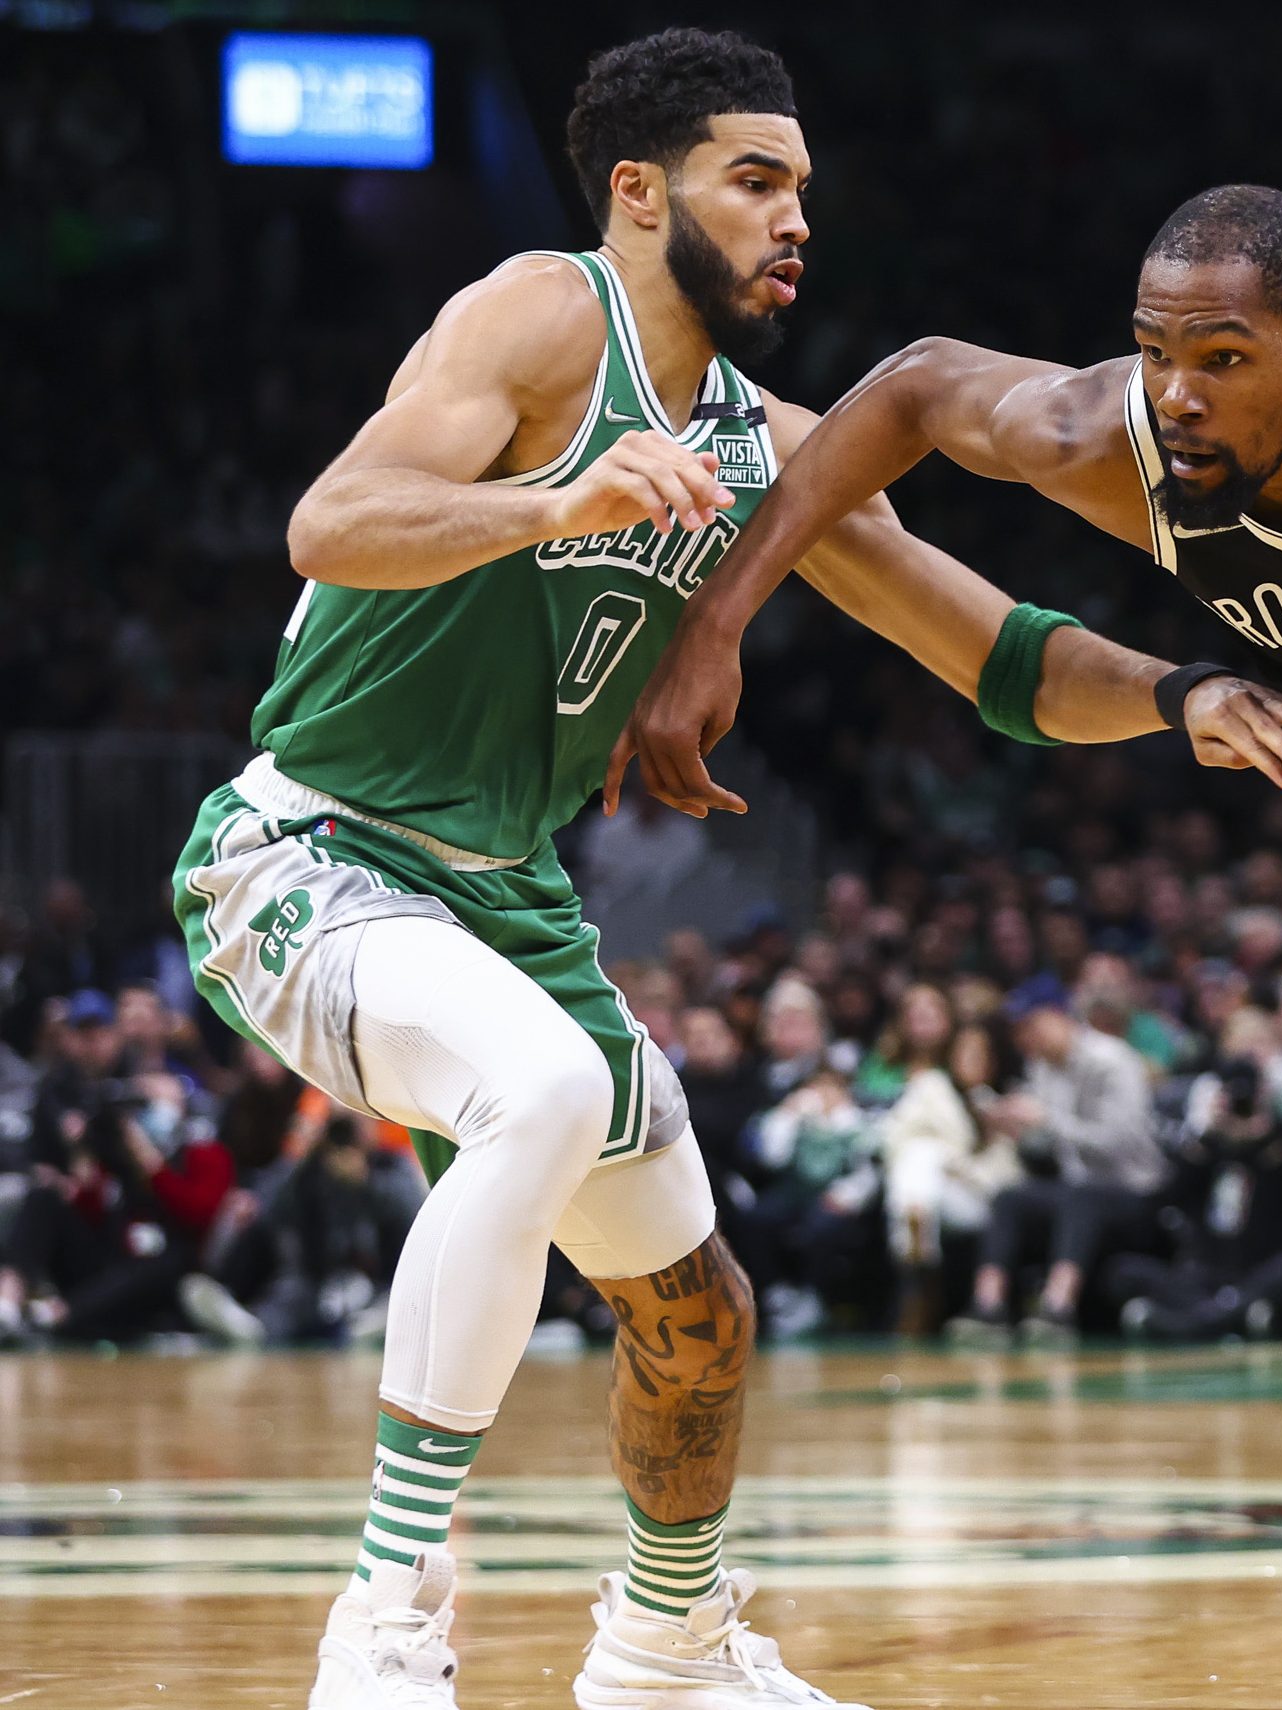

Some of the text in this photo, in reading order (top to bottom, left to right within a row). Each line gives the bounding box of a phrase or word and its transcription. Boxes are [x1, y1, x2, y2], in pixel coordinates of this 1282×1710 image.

[718, 441, 761, 465] VISTA
[719, 468, 748, 482] PRINT
[557, 591, 646, 715] 0
[265, 901, 300, 959] RED
